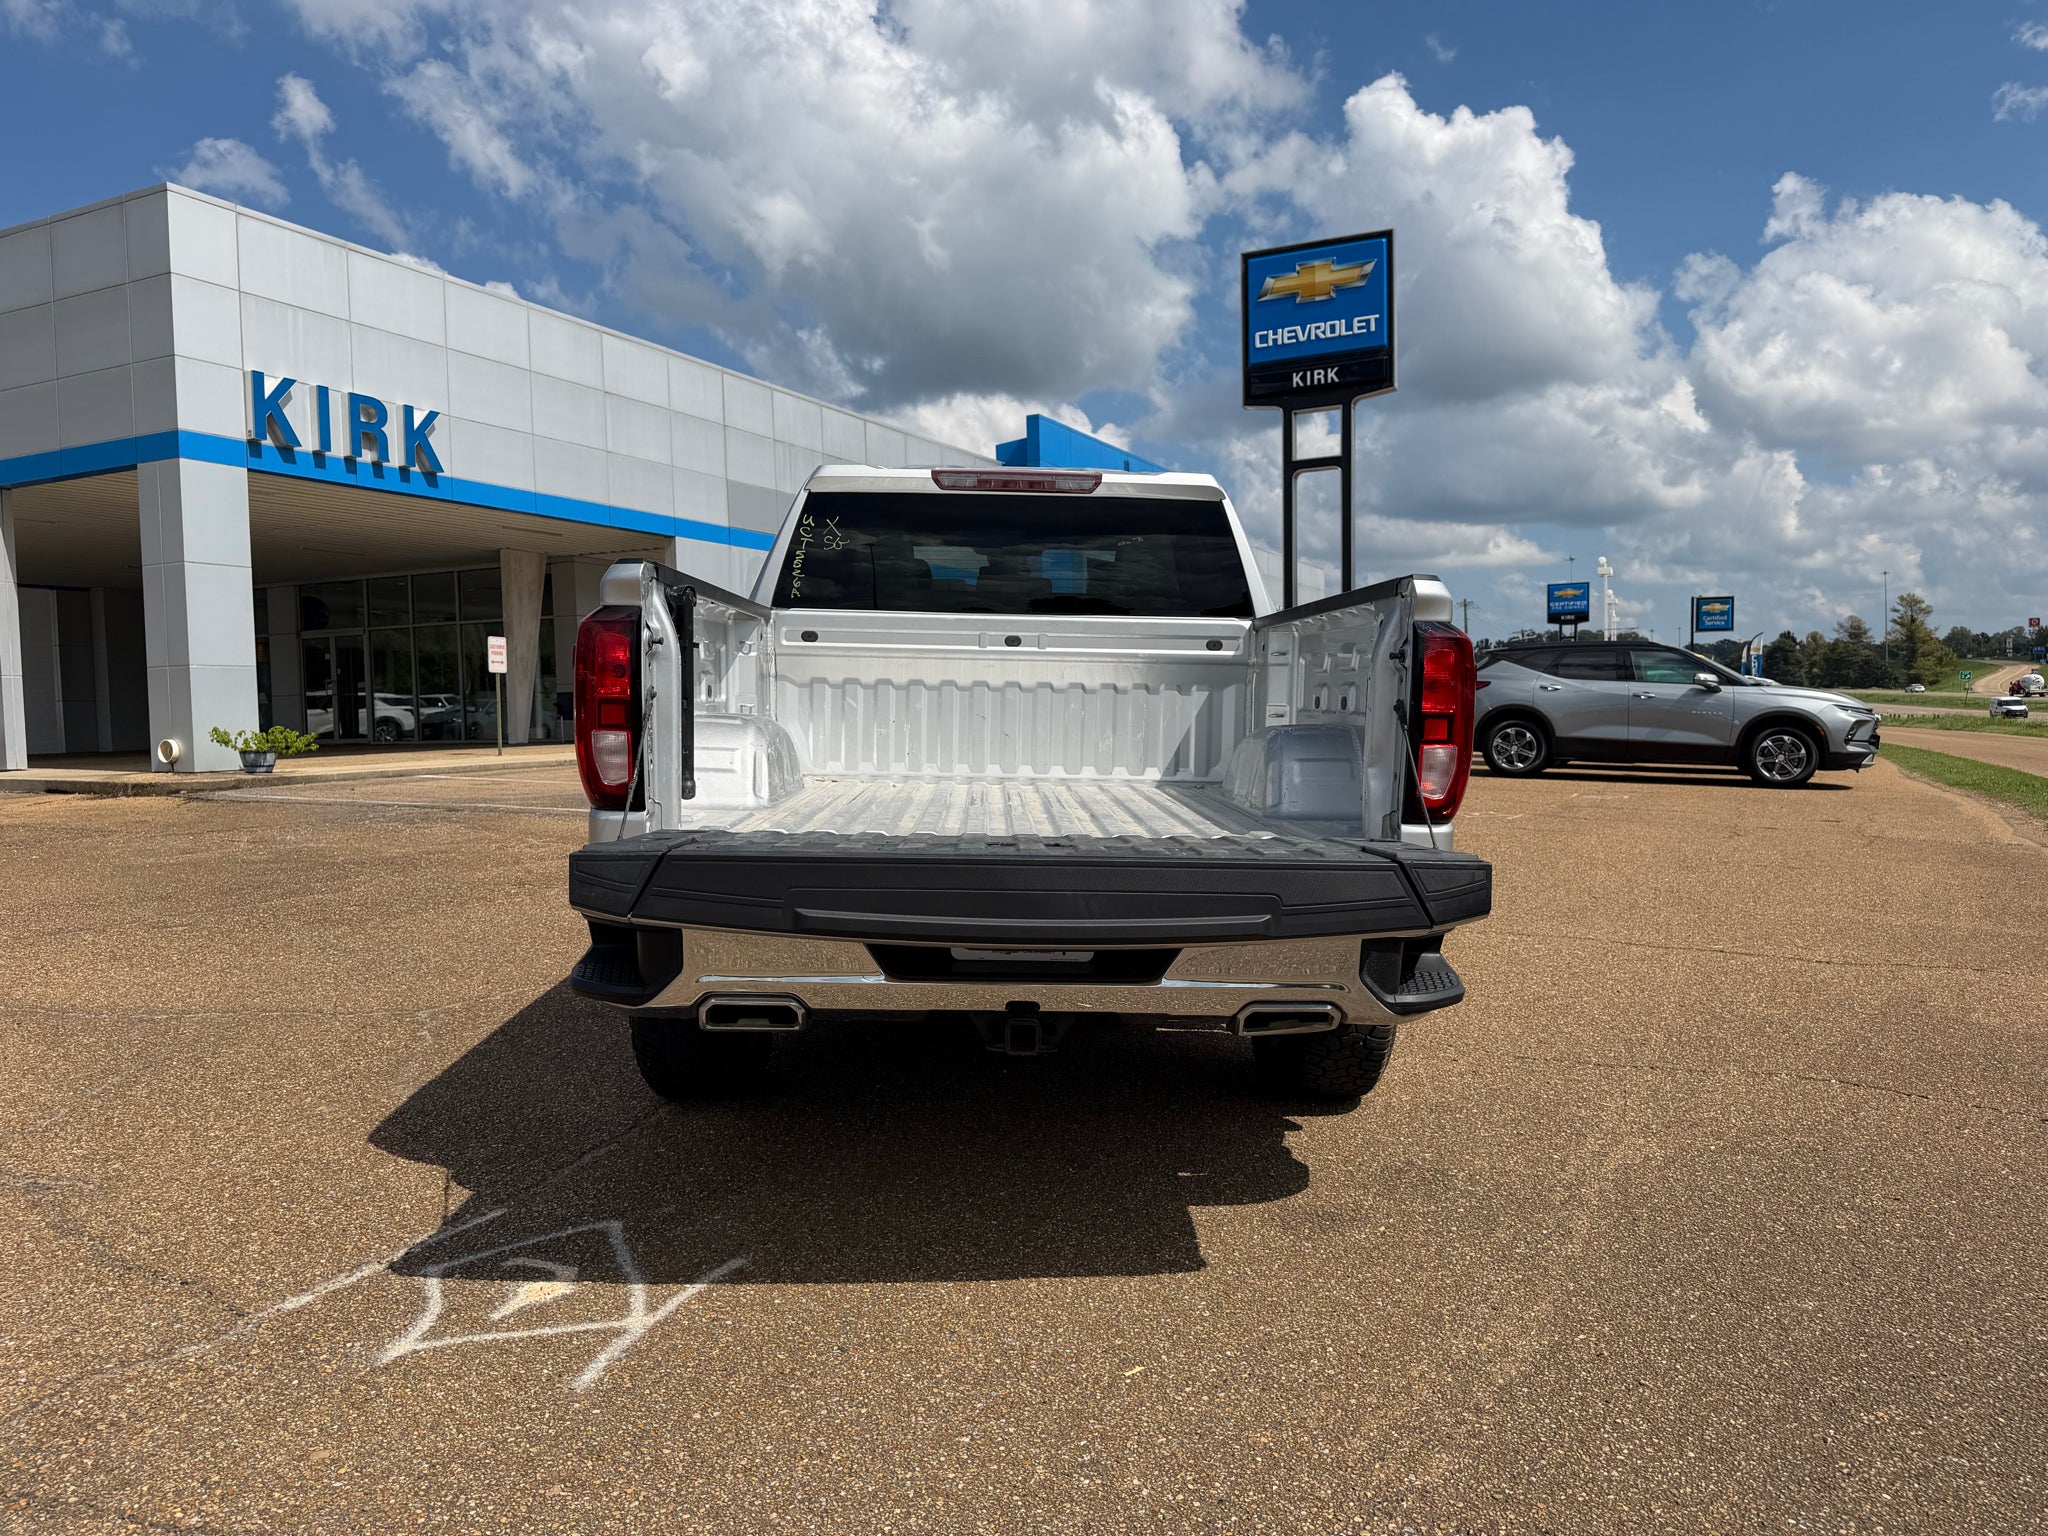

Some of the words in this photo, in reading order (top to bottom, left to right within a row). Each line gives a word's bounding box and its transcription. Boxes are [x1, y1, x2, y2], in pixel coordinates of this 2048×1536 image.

[1254, 314, 1380, 349] CHEVROLET
[1292, 366, 1339, 387] KIRK
[249, 370, 444, 473] KIRK
